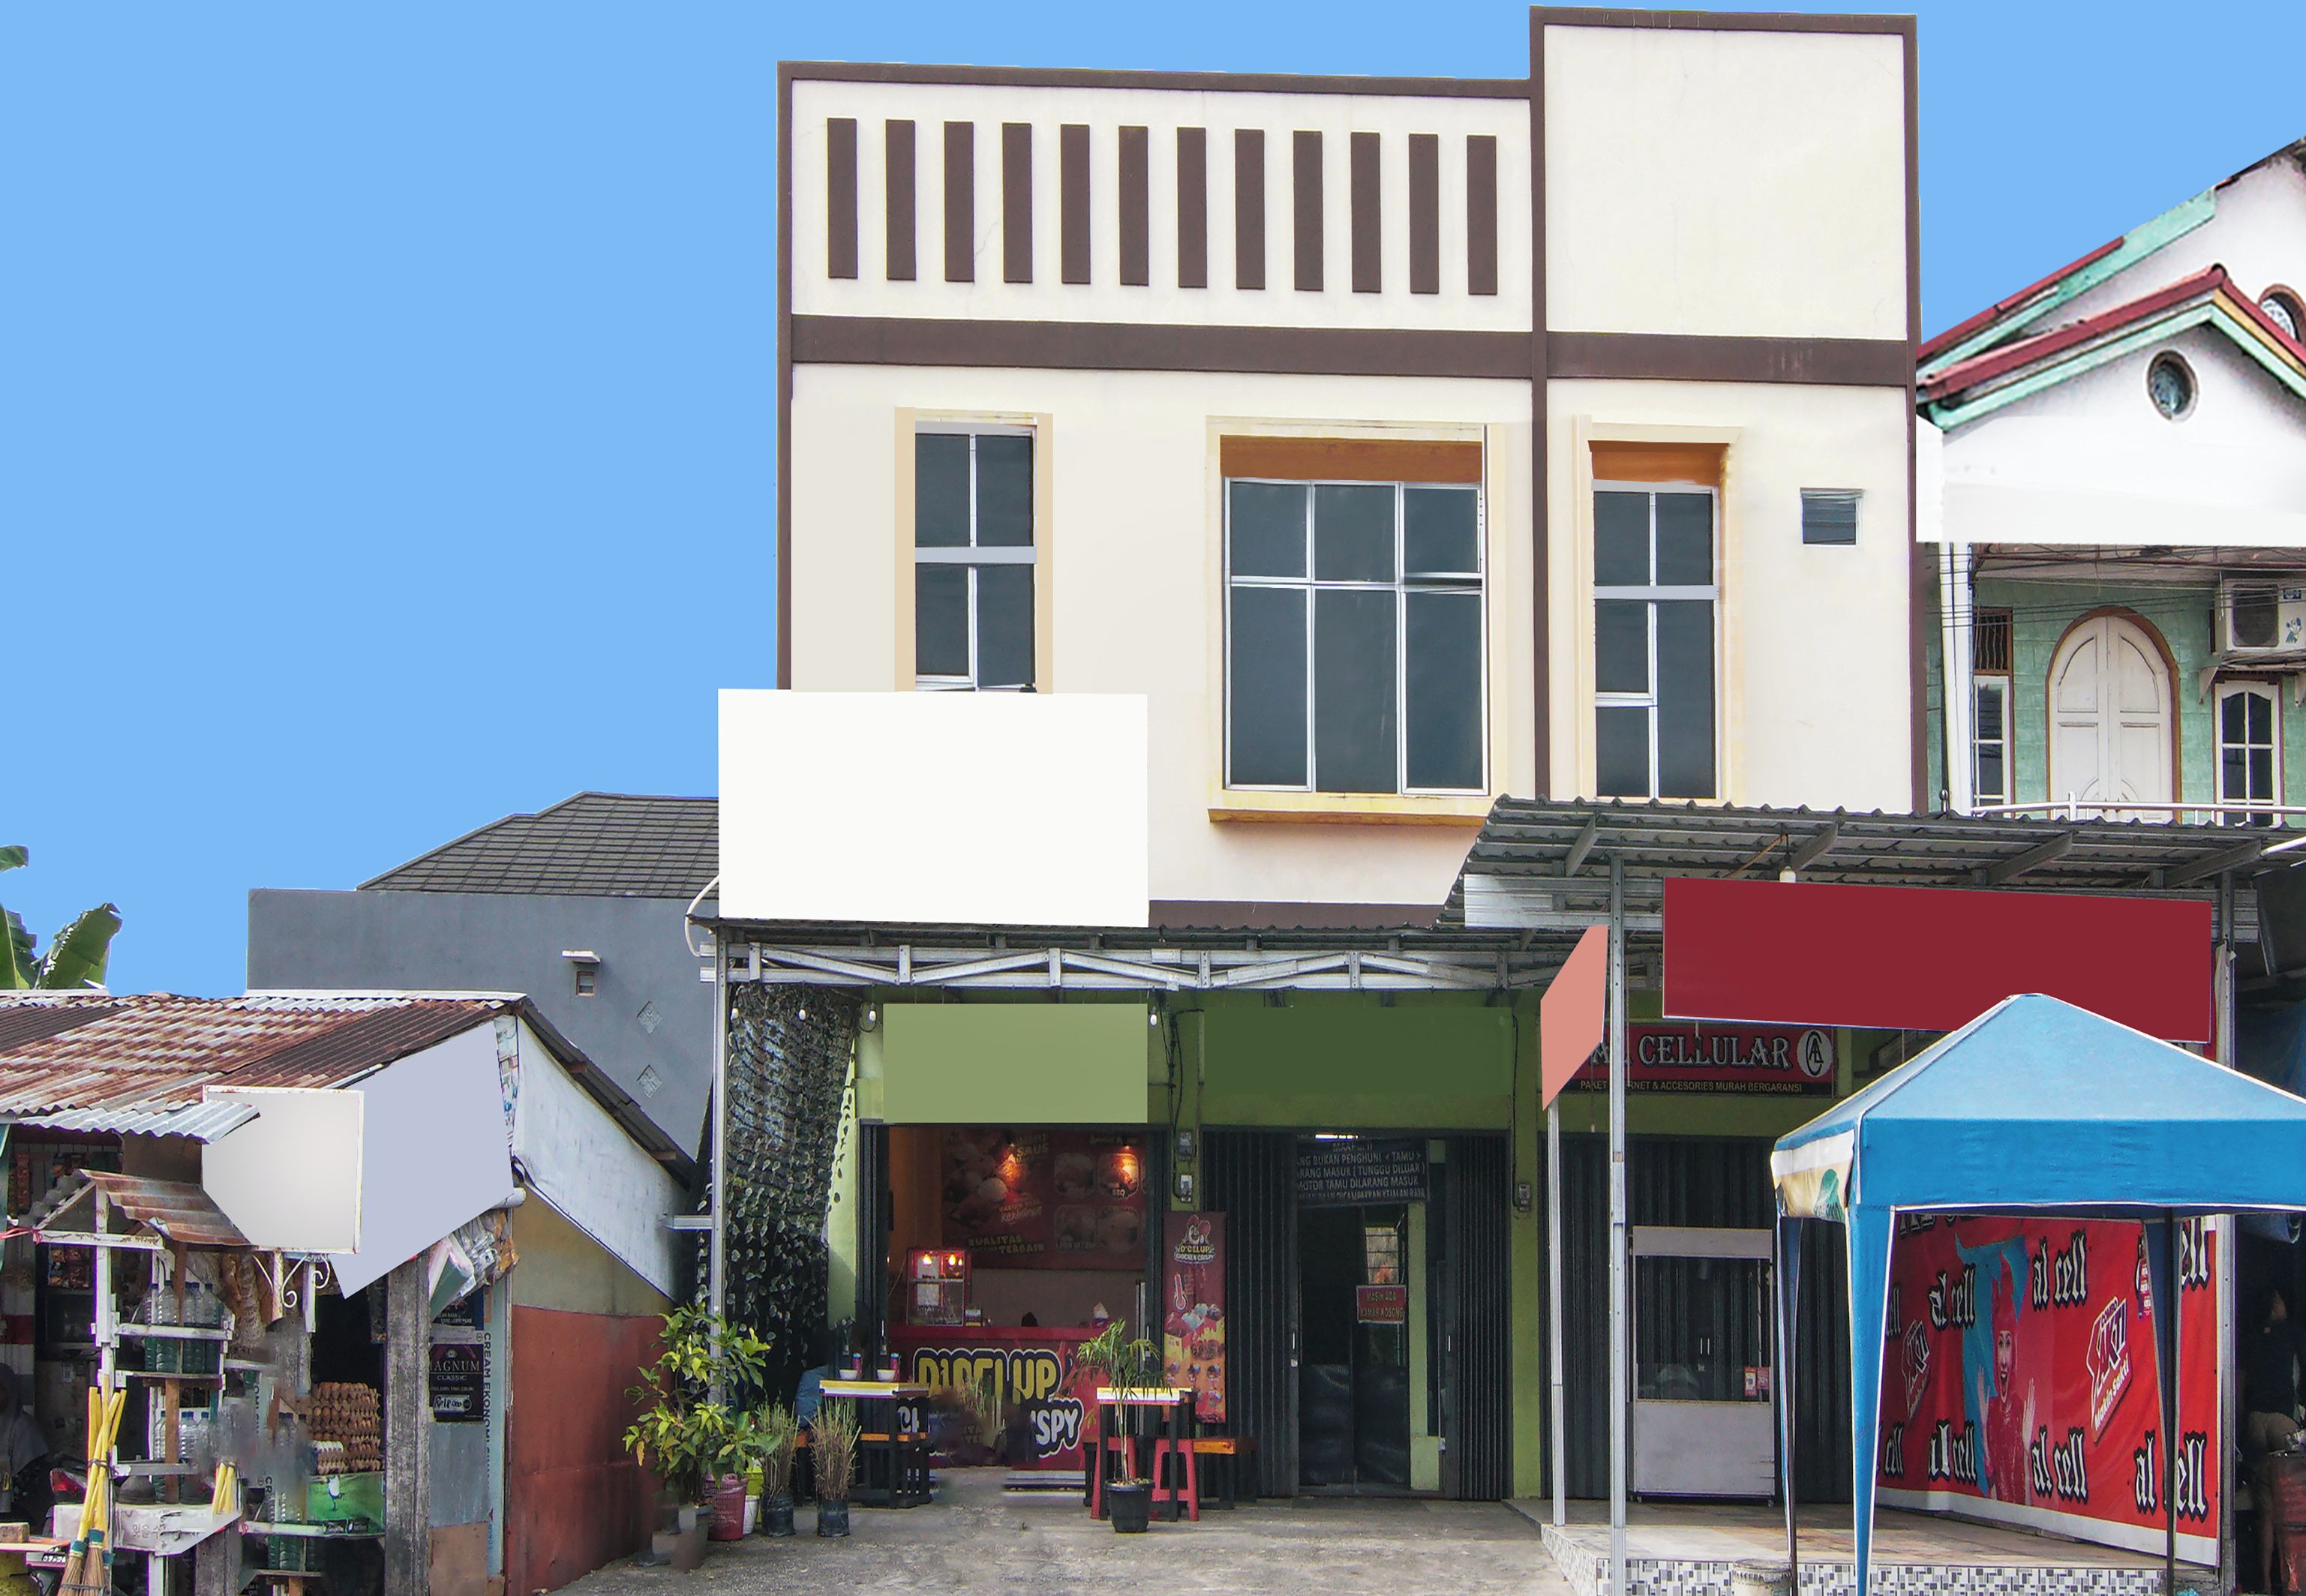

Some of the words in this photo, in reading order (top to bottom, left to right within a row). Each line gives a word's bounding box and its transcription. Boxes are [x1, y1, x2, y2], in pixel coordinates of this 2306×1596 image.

[1638, 1034, 1792, 1070] CELLULAR
[1660, 1082, 1713, 1092] ACCESORIES
[1716, 1082, 1746, 1092] MURAH
[1748, 1082, 1802, 1093] BERGARANSI
[1313, 1154, 1340, 1166] BUKAN
[1341, 1153, 1382, 1165] PENGHUNI
[1323, 1166, 1351, 1178] MASUK
[1326, 1179, 1348, 1190] TAMU
[1350, 1177, 1389, 1188] DILARANG
[1390, 1175, 1419, 1186] MASUK
[430, 1360, 481, 1372] AGNUM
